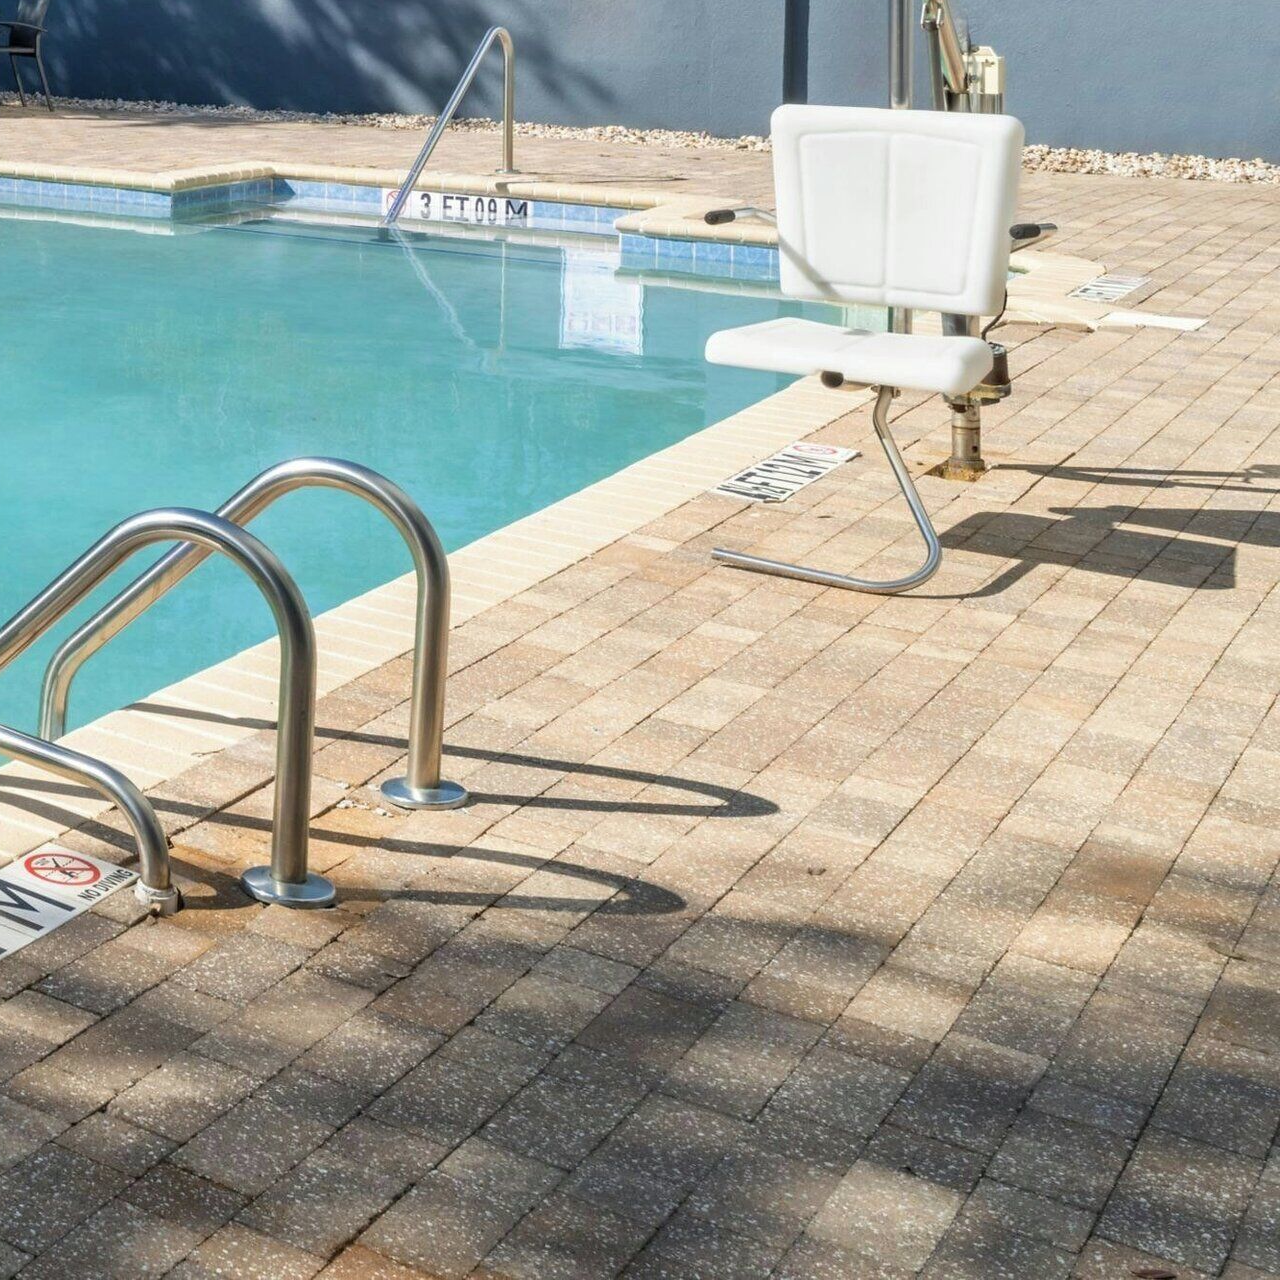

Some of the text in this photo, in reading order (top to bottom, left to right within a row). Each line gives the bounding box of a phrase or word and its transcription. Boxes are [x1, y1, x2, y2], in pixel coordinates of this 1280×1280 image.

[505, 200, 528, 216] M
[772, 453, 838, 469] M
[77, 868, 134, 902] NO DIVING
